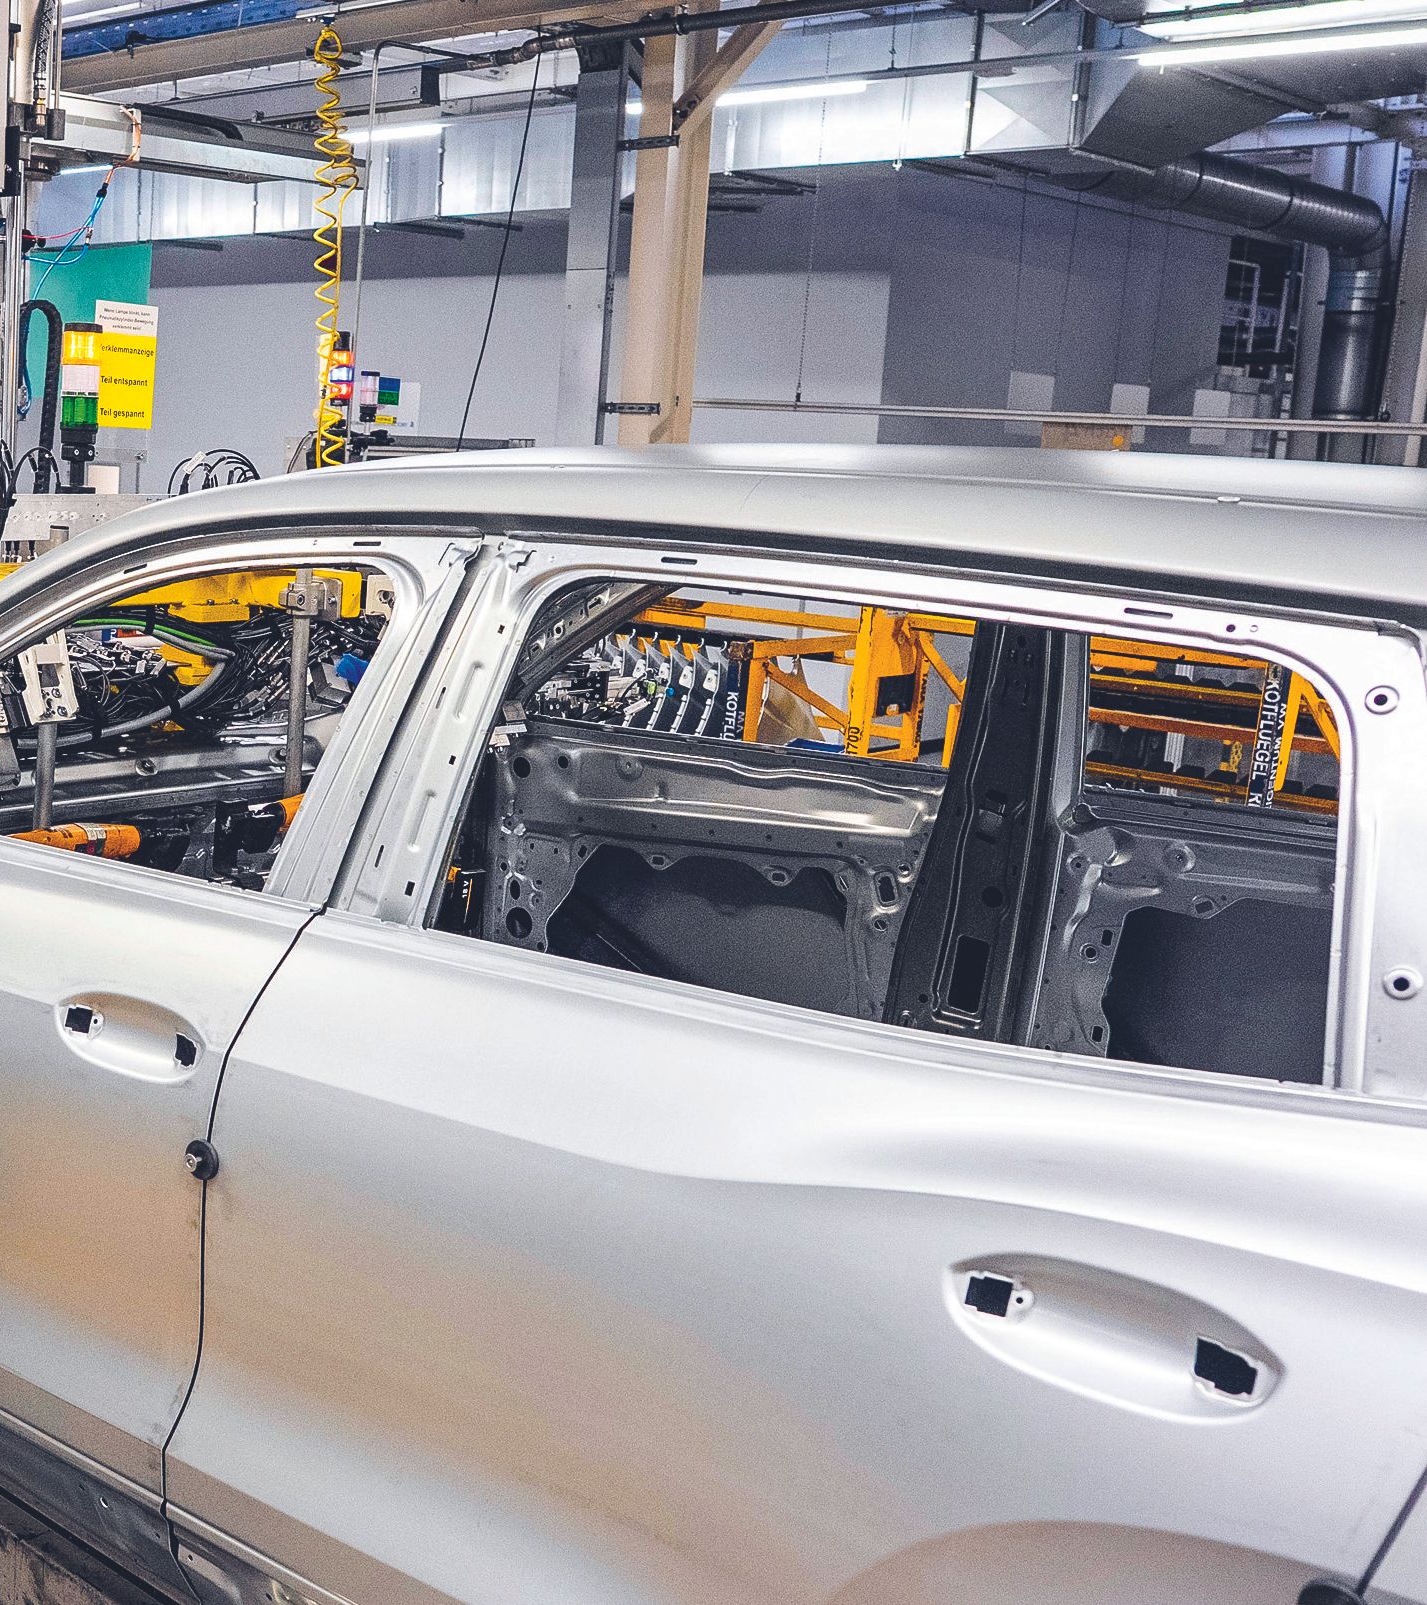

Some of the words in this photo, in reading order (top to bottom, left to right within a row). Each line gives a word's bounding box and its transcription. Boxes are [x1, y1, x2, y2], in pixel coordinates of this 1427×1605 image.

[100, 344, 154, 357] erklemmanzeige
[100, 375, 112, 384] Teil
[113, 377, 148, 387] entspannt
[99, 407, 112, 417] Teil
[113, 409, 145, 419] gespannt
[1251, 680, 1281, 780] KOTFLUEGEL
[1247, 792, 1263, 808] R
